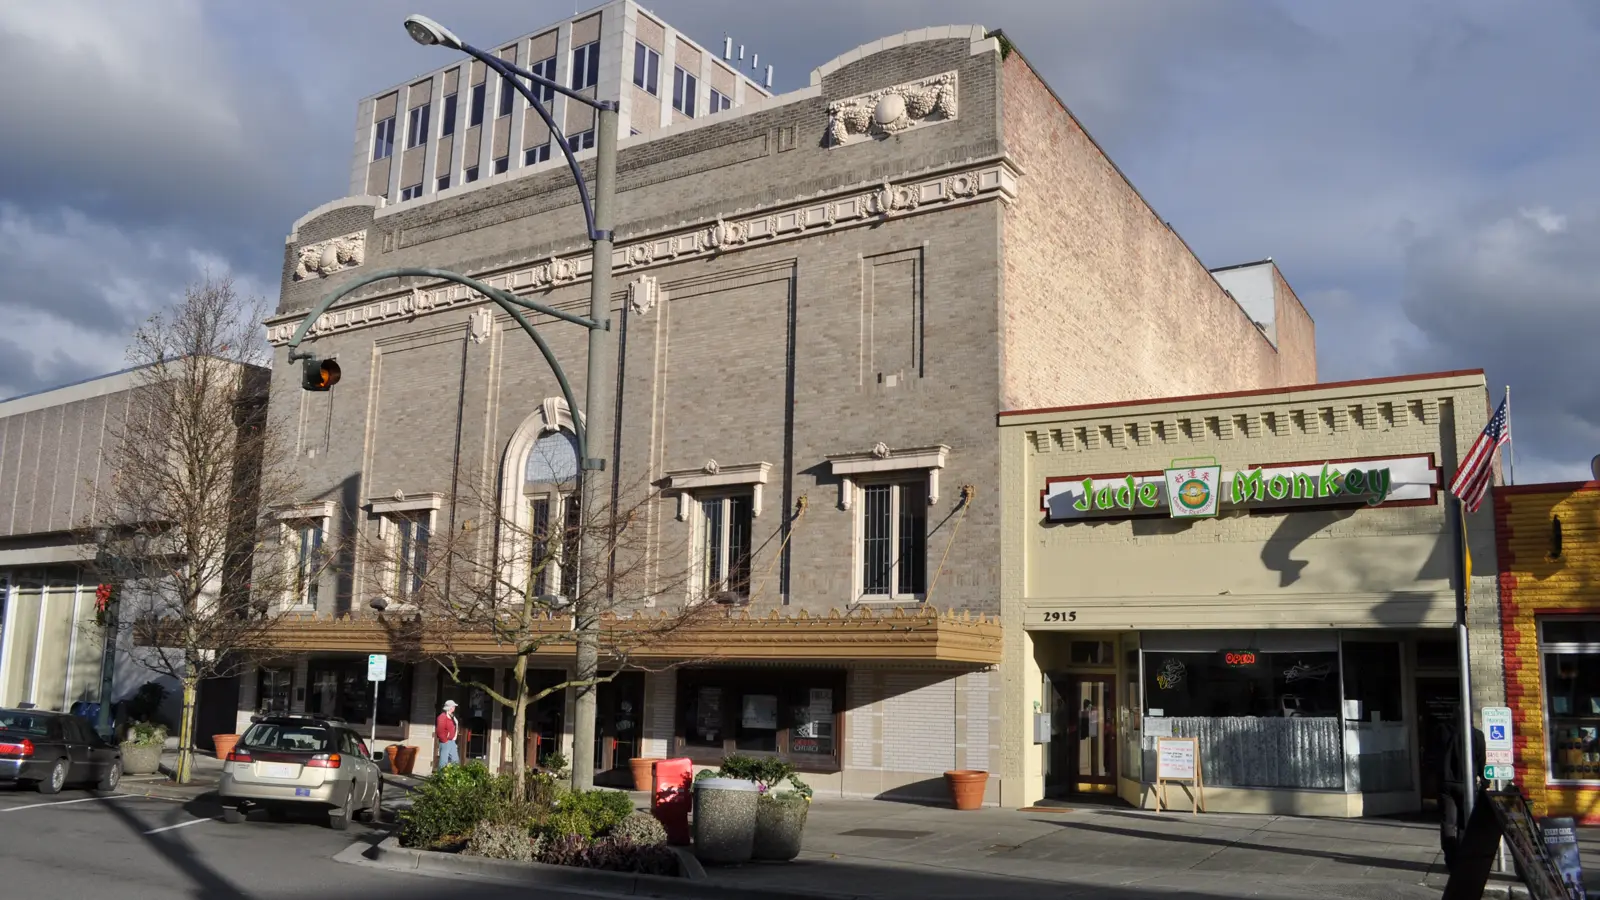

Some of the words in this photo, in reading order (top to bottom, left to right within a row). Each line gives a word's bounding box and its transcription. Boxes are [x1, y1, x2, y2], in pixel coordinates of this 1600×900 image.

[1073, 474, 1159, 511] Jade
[1231, 461, 1391, 507] Monkey
[1043, 611, 1077, 622] 2915
[1225, 652, 1255, 664] OPEN
[1486, 767, 1493, 777] 4
